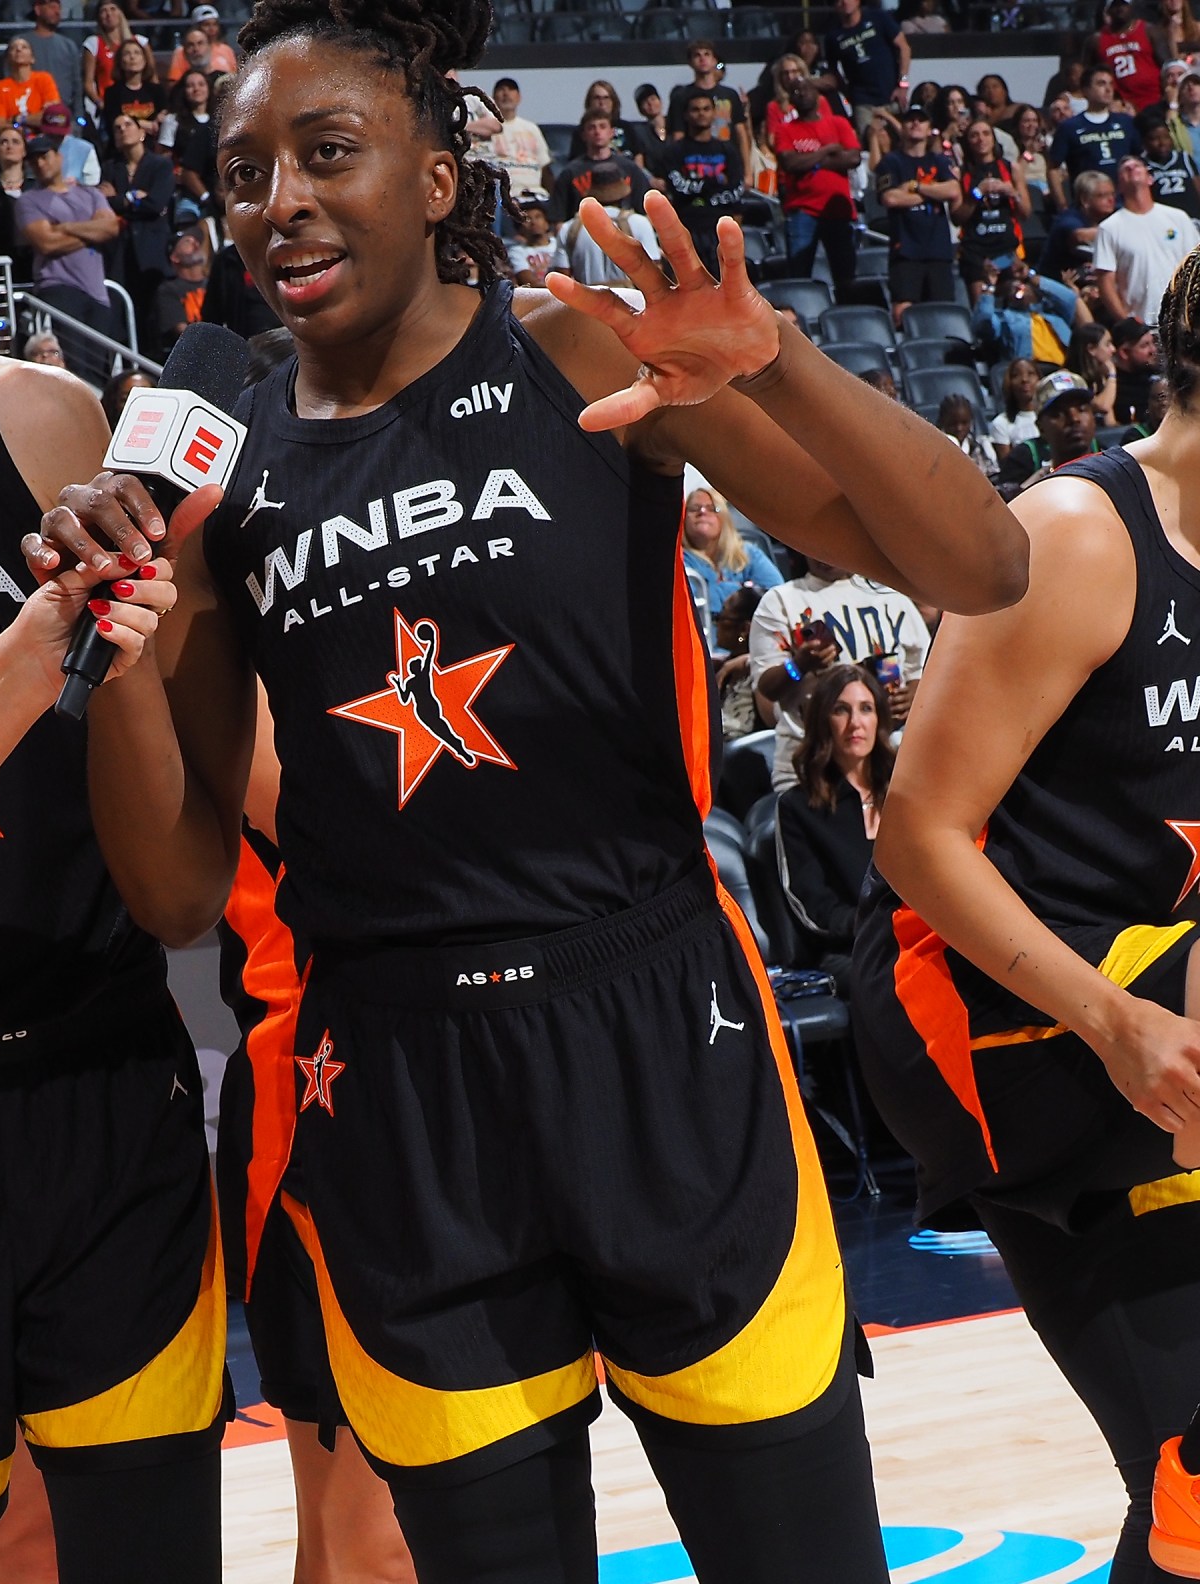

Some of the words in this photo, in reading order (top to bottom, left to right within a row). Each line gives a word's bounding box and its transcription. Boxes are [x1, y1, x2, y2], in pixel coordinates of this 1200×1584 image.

[1114, 54, 1137, 79] 21
[1100, 141, 1112, 159] 5
[1158, 176, 1186, 195] 22
[450, 381, 514, 418] ally
[245, 468, 553, 617] WNBA
[284, 537, 515, 634] ALL-STAR
[800, 604, 906, 661] NDY
